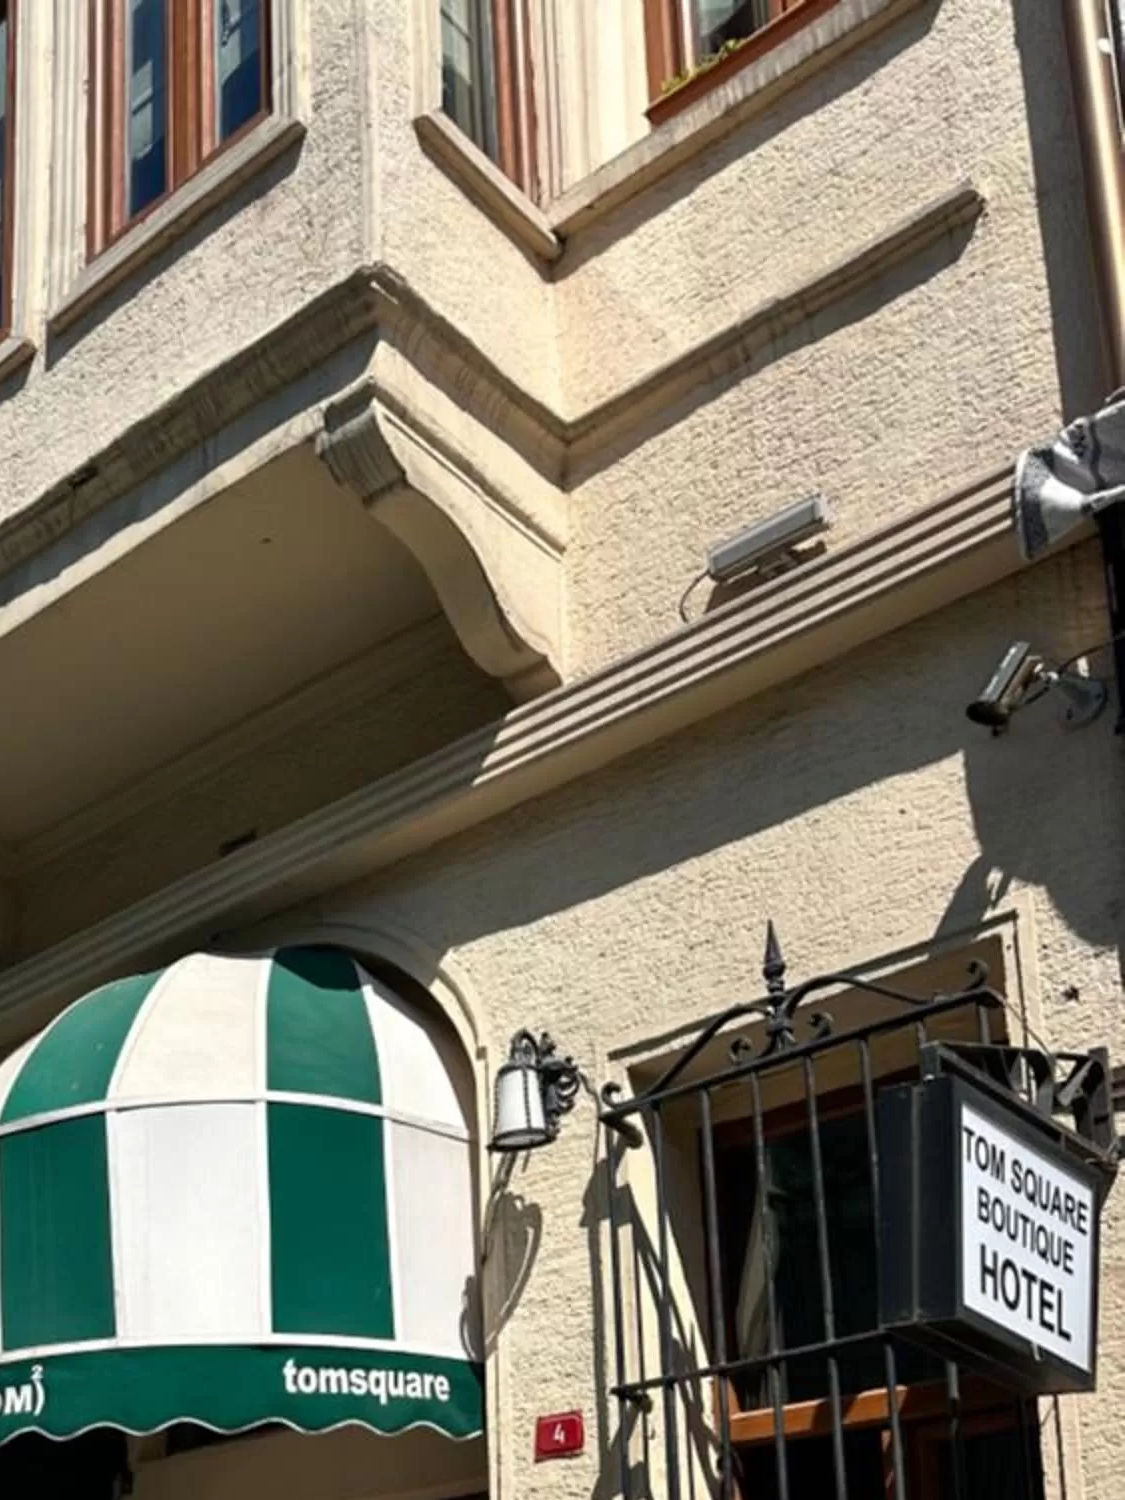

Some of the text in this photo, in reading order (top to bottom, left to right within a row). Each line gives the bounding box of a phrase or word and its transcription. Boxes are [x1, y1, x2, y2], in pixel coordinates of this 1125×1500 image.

[962, 1125, 1088, 1236] TOM SQUARE
[977, 1186, 1074, 1275] BOUTIQUE
[979, 1243, 1072, 1342] HOTEL
[282, 1359, 450, 1404] tomsquare
[553, 1423, 565, 1444] 4
